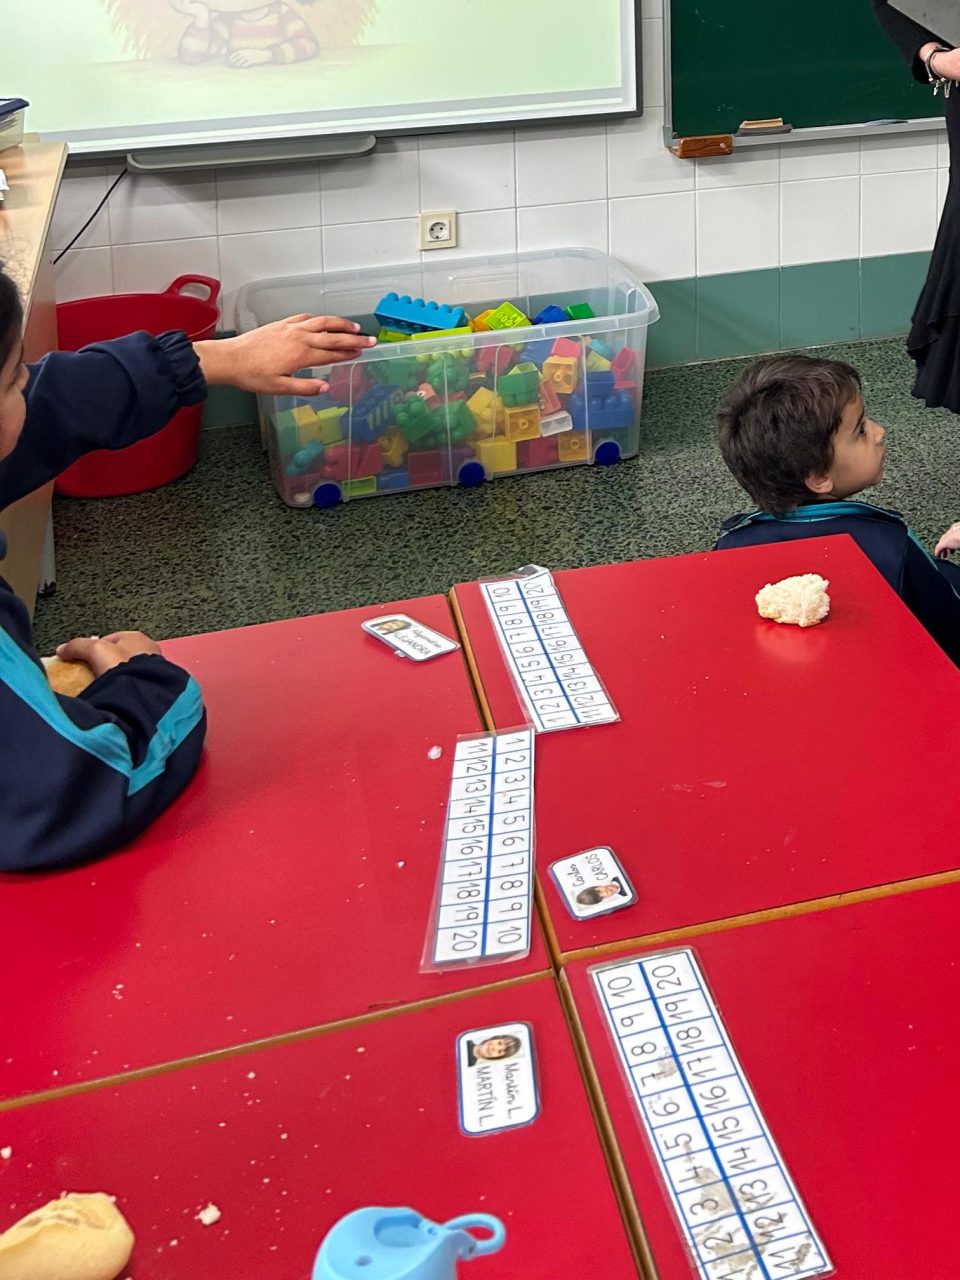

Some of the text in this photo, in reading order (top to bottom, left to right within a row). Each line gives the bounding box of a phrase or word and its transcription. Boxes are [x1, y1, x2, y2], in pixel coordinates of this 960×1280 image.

[505, 755, 525, 765] 2
[505, 774, 525, 784] 3
[504, 795, 525, 804] 4
[504, 815, 524, 825] 5
[453, 742, 488, 951] 11 12 13 14 15 16 17 18 19 20
[503, 837, 524, 846] 6
[502, 858, 524, 867] 7
[586, 854, 608, 881] CARLOS
[501, 880, 523, 890] 8
[500, 902, 522, 912] 9
[498, 926, 521, 944] 10
[608, 976, 635, 997] 10
[621, 1012, 644, 1027] 9
[631, 1042, 657, 1056] 8
[641, 1071, 664, 1087] 7
[477, 1066, 497, 1111] MARTÍN
[653, 1102, 680, 1117] 6
[651, 965, 802, 1270] 11 12 13 14 15 16 17 18 19 20
[664, 1133, 692, 1150] 5
[679, 1166, 701, 1183] 4
[690, 1199, 718, 1215] 3
[703, 1232, 733, 1250] 2
